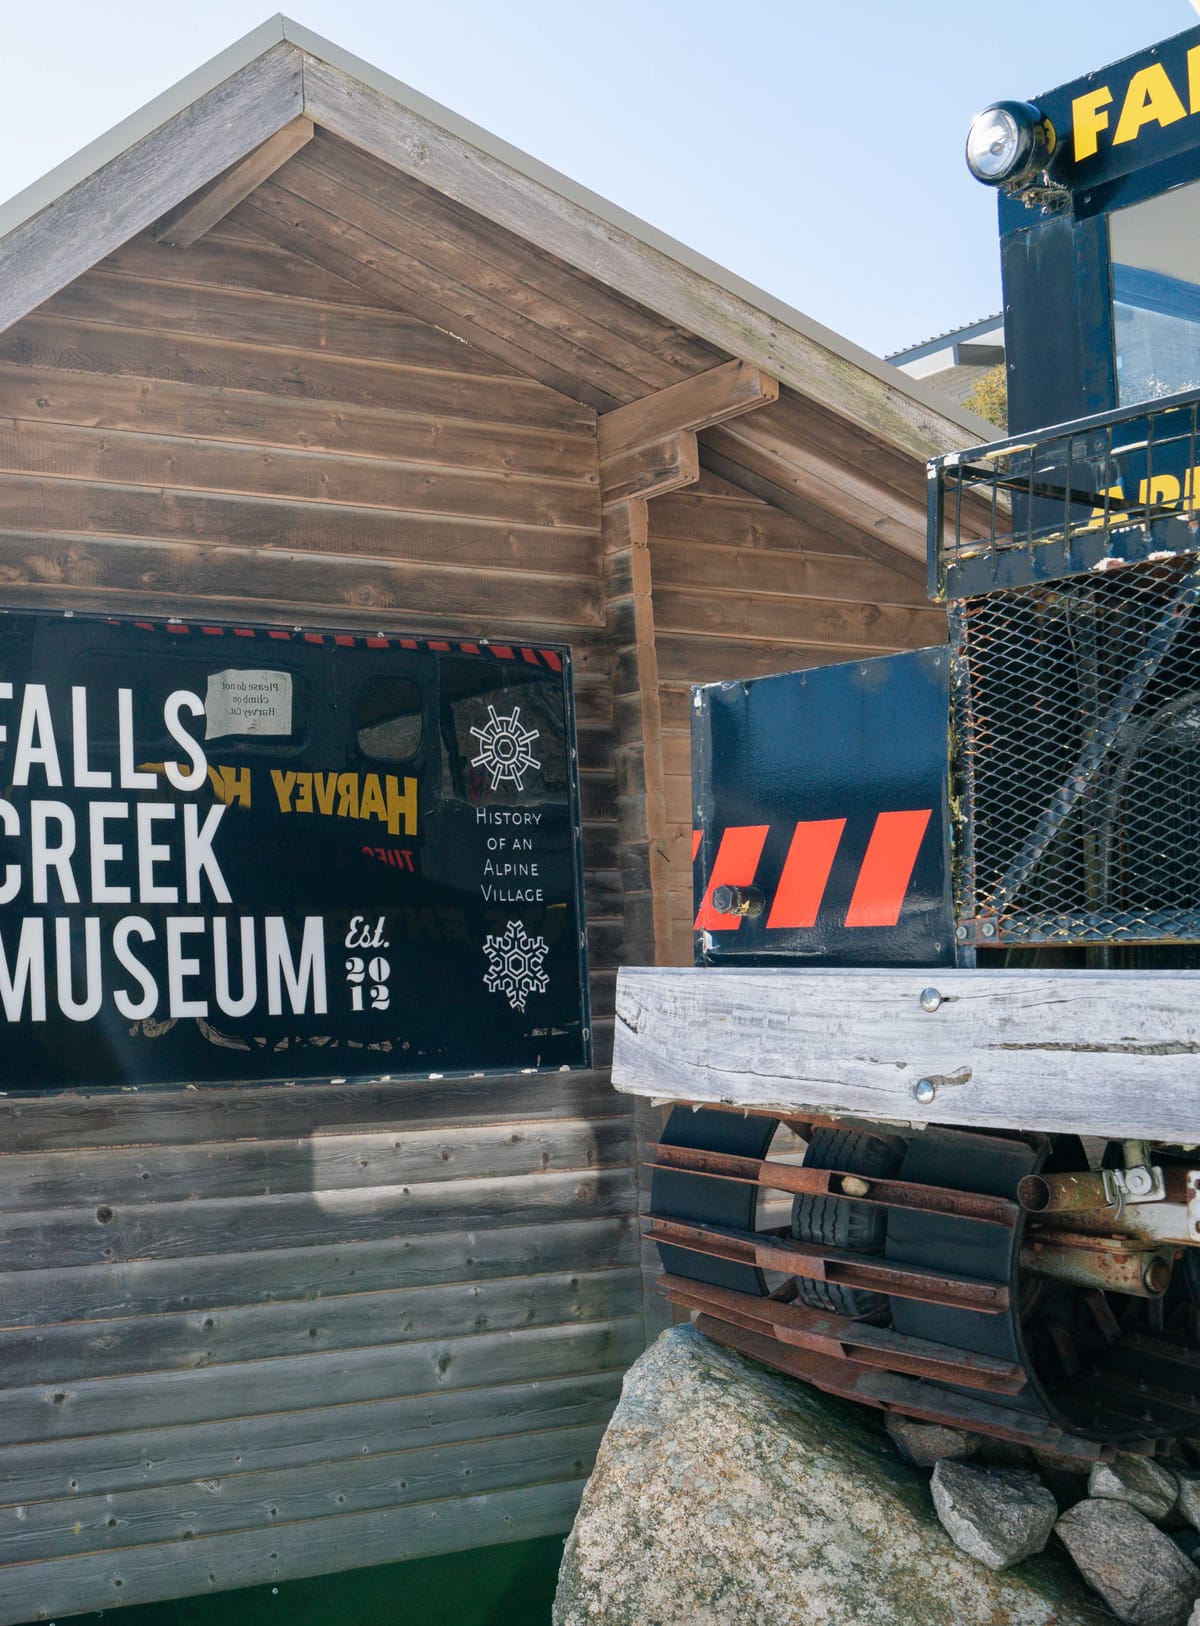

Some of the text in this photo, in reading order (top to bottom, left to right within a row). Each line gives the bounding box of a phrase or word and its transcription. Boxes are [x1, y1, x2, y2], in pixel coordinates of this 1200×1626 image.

[344, 915, 390, 948] Est.
[345, 956, 391, 983] 20
[349, 984, 390, 1011] 12
